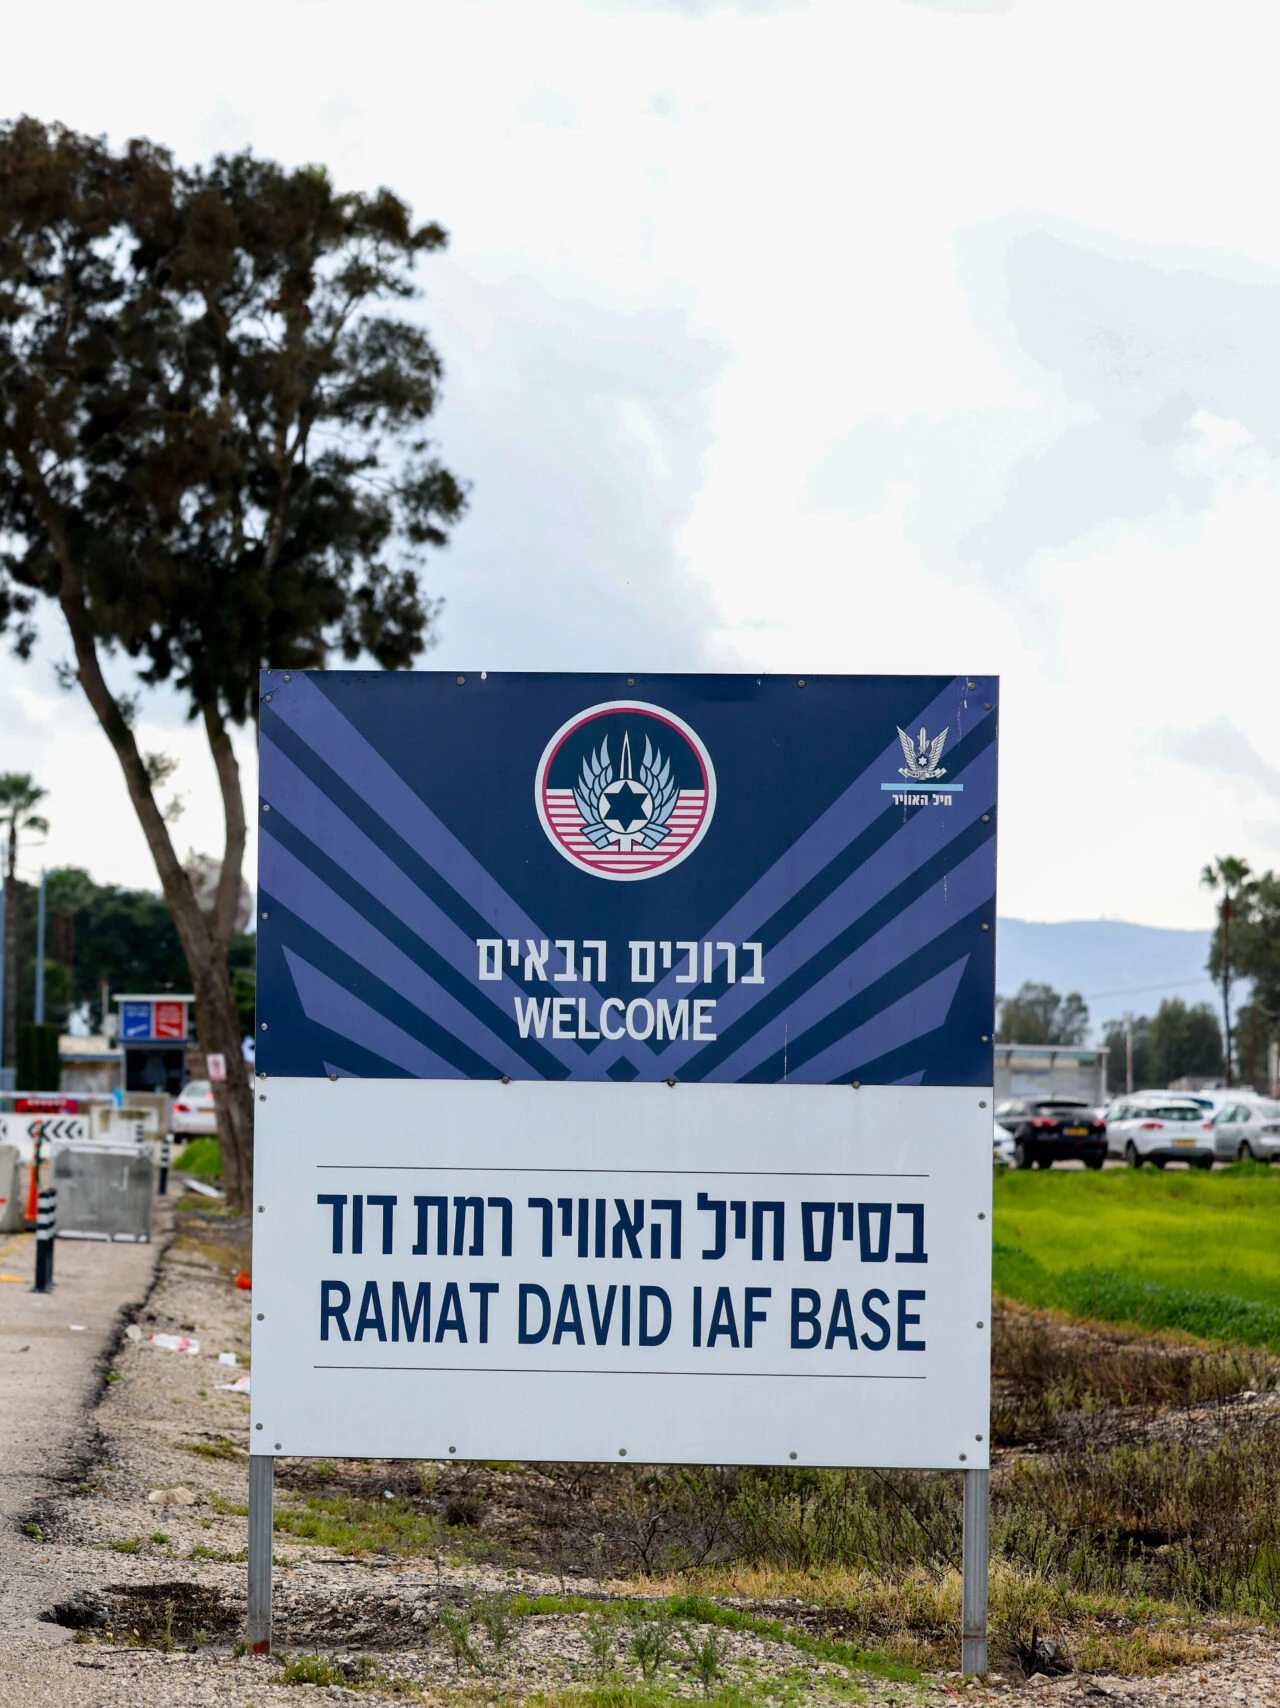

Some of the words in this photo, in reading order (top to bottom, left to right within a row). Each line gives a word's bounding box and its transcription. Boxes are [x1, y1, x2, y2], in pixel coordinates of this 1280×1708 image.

[892, 794, 928, 806] האוויר
[932, 794, 952, 806] חיל
[477, 939, 606, 982] הבאים
[629, 941, 764, 984] ברוכים
[514, 997, 716, 1041] WELCOME
[317, 1194, 397, 1255] דוד
[412, 1196, 512, 1257] רמת
[528, 1198, 681, 1260] האוויר
[697, 1193, 784, 1262] חיל
[801, 1202, 928, 1264] בסיס
[321, 1280, 499, 1344] RAMAT
[518, 1284, 671, 1347] DAVID
[693, 1287, 771, 1349] IAF
[791, 1288, 926, 1352] BASE
